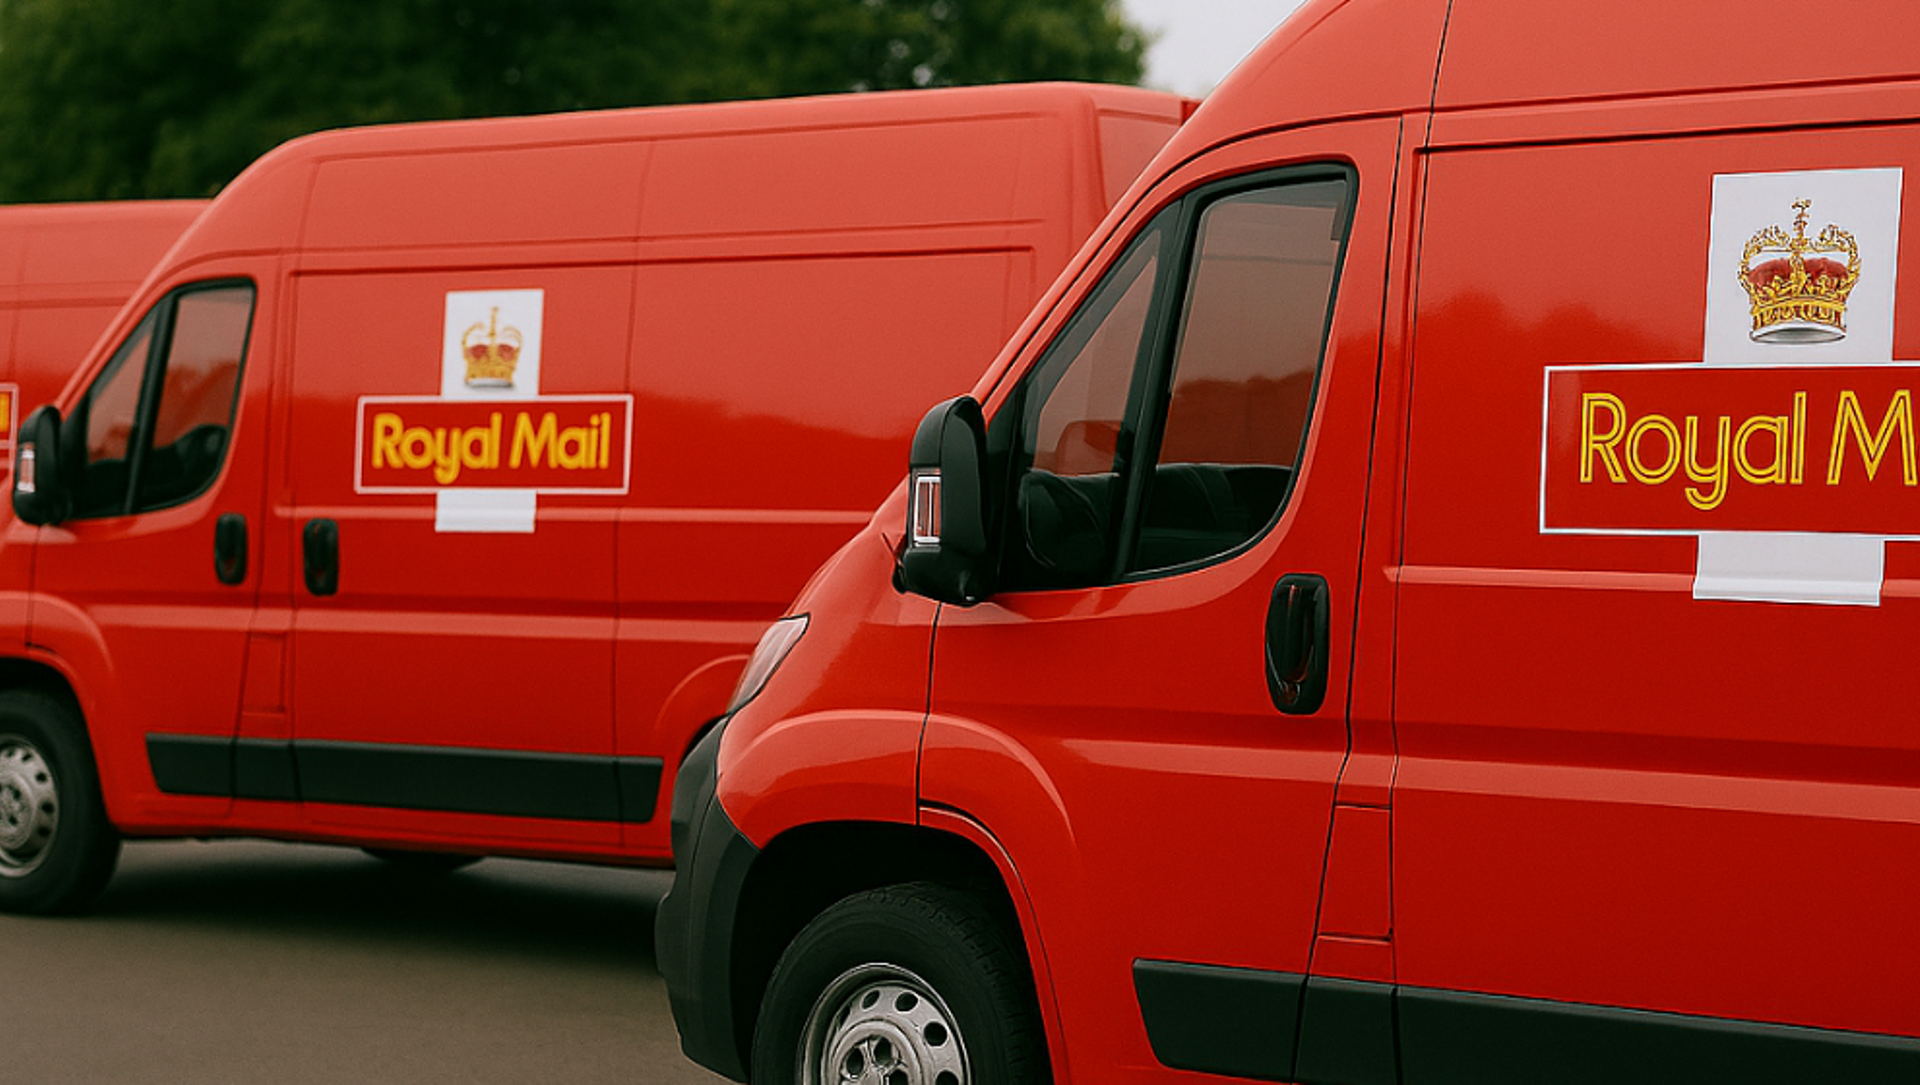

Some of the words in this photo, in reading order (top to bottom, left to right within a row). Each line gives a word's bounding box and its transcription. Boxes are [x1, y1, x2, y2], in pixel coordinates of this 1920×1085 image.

[372, 412, 502, 485] Royal
[509, 411, 611, 469] Mail
[1580, 391, 1806, 510] Royal
